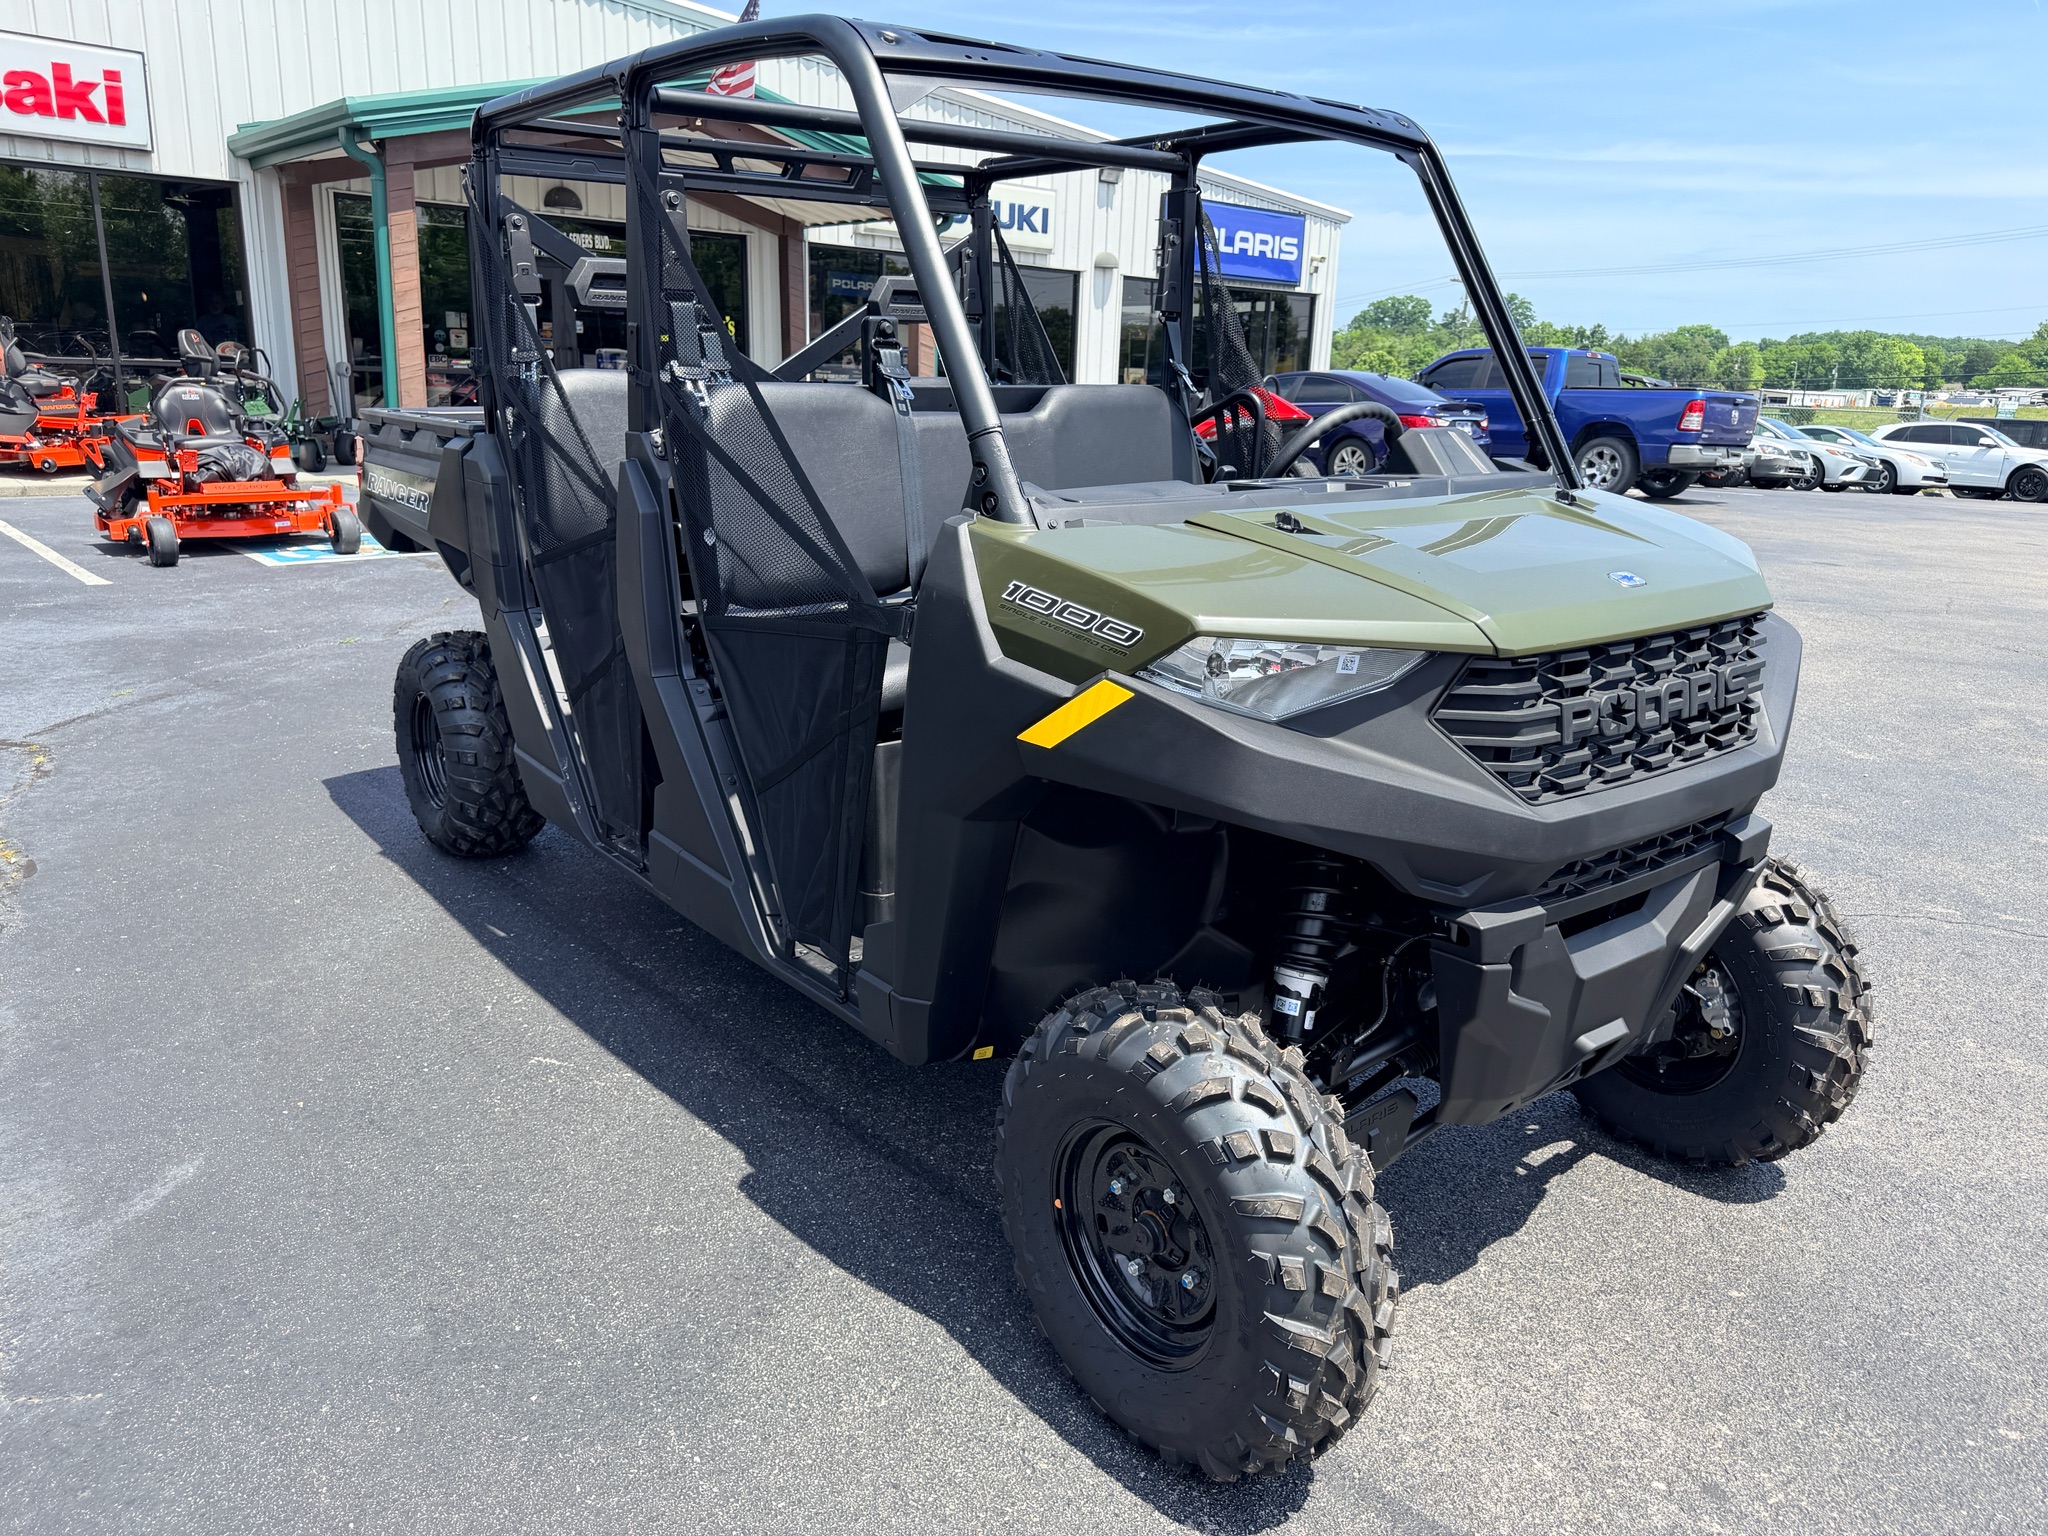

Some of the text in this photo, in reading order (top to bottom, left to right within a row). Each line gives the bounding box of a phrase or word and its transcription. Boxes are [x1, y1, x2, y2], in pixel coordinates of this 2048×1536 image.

[0, 61, 126, 126] aki
[1195, 225, 1299, 261] LARIS
[591, 294, 627, 302] RANG
[832, 278, 876, 290] POLAR
[40, 403, 77, 411] MAVERICK
[366, 472, 431, 514] RANGER
[998, 603, 1129, 658] SINGLE OVERHEAD CAM
[1001, 580, 1146, 648] 1000
[1560, 661, 1750, 746] POLARIS
[1344, 1101, 1399, 1136] LARIS
